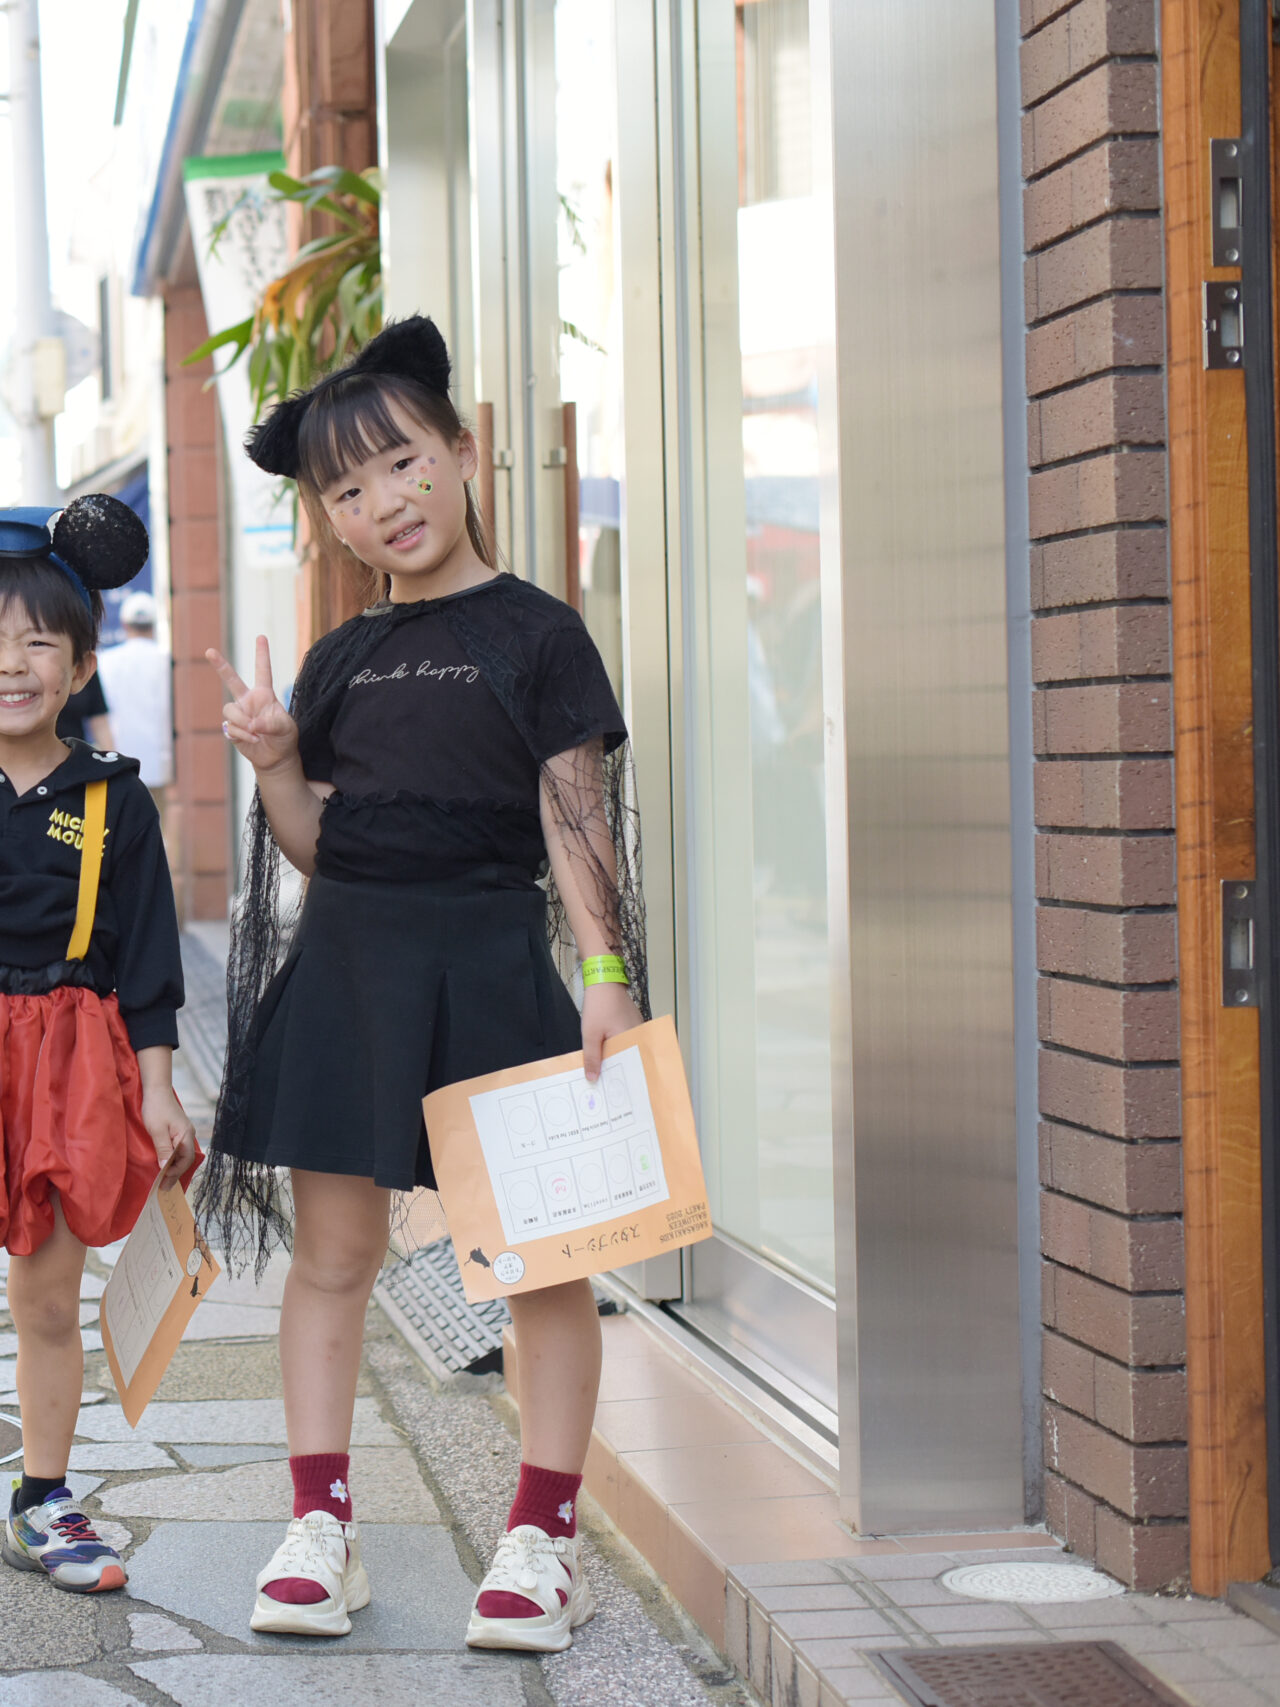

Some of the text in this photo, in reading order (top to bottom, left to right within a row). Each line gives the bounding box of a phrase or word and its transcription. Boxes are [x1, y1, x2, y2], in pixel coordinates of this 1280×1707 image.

[348, 660, 481, 689] think happy
[48, 808, 110, 838] MIC
[561, 1223, 641, 1259] スタンプシート
